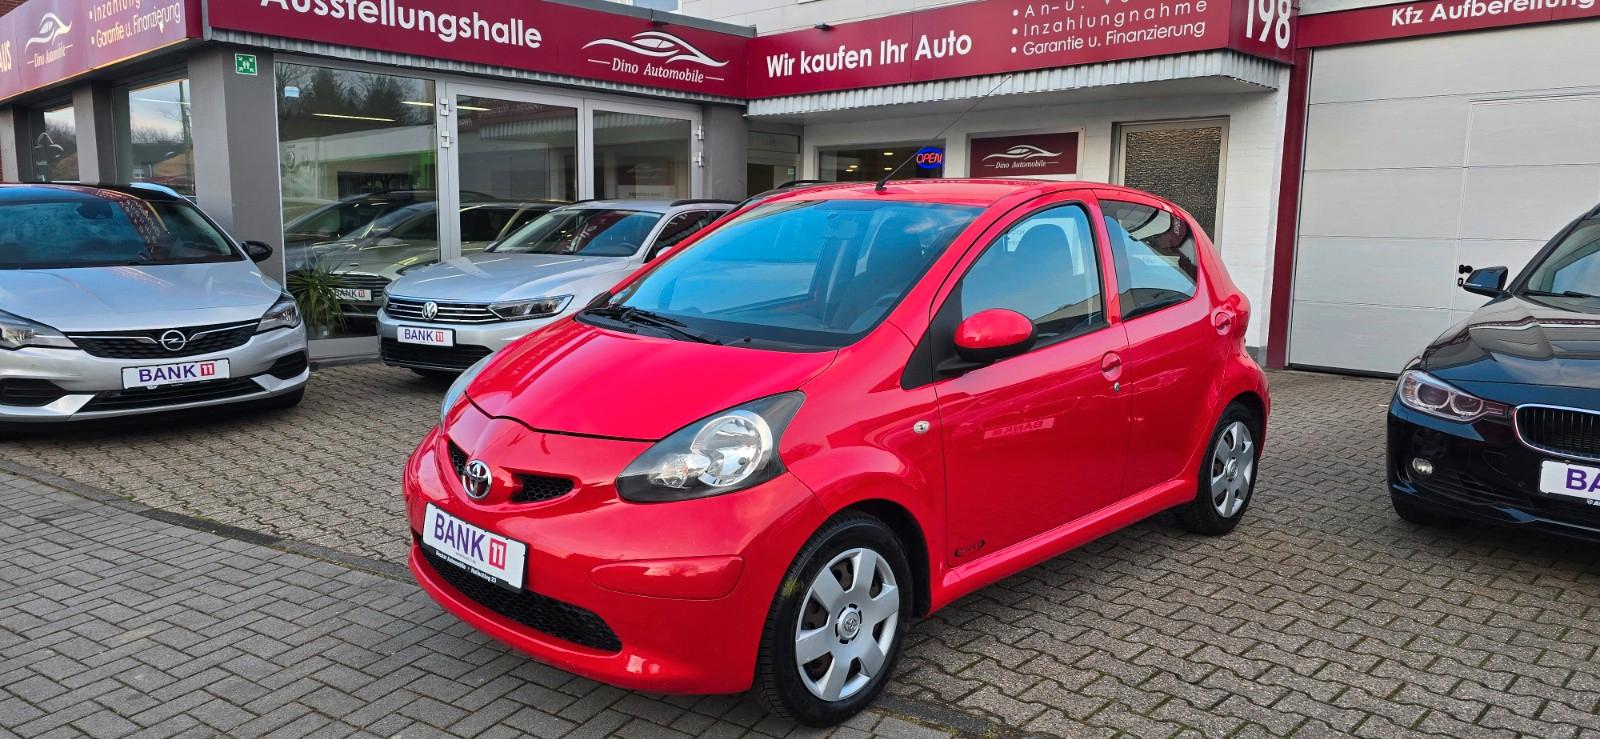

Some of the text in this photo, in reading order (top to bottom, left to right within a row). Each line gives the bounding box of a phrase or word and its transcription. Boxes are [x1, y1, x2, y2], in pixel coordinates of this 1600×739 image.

[96, 22, 124, 47] Garantie
[133, 2, 180, 34] Finanzierung
[1023, 2, 1208, 37] Inzahlungnahme
[1245, 0, 1292, 49] 198
[1391, 8, 1423, 26] Kfz
[766, 30, 972, 78] Wir kaufen Ihr Auto
[1023, 21, 1206, 56] Garantie u. Finanzierung
[612, 56, 704, 83] Dino Automobile
[915, 153, 943, 165] OPEN
[996, 159, 1047, 169] Dino Automobile
[404, 328, 444, 343] BANK 11
[139, 364, 214, 382] BANK 11
[434, 512, 506, 568] BANK 11
